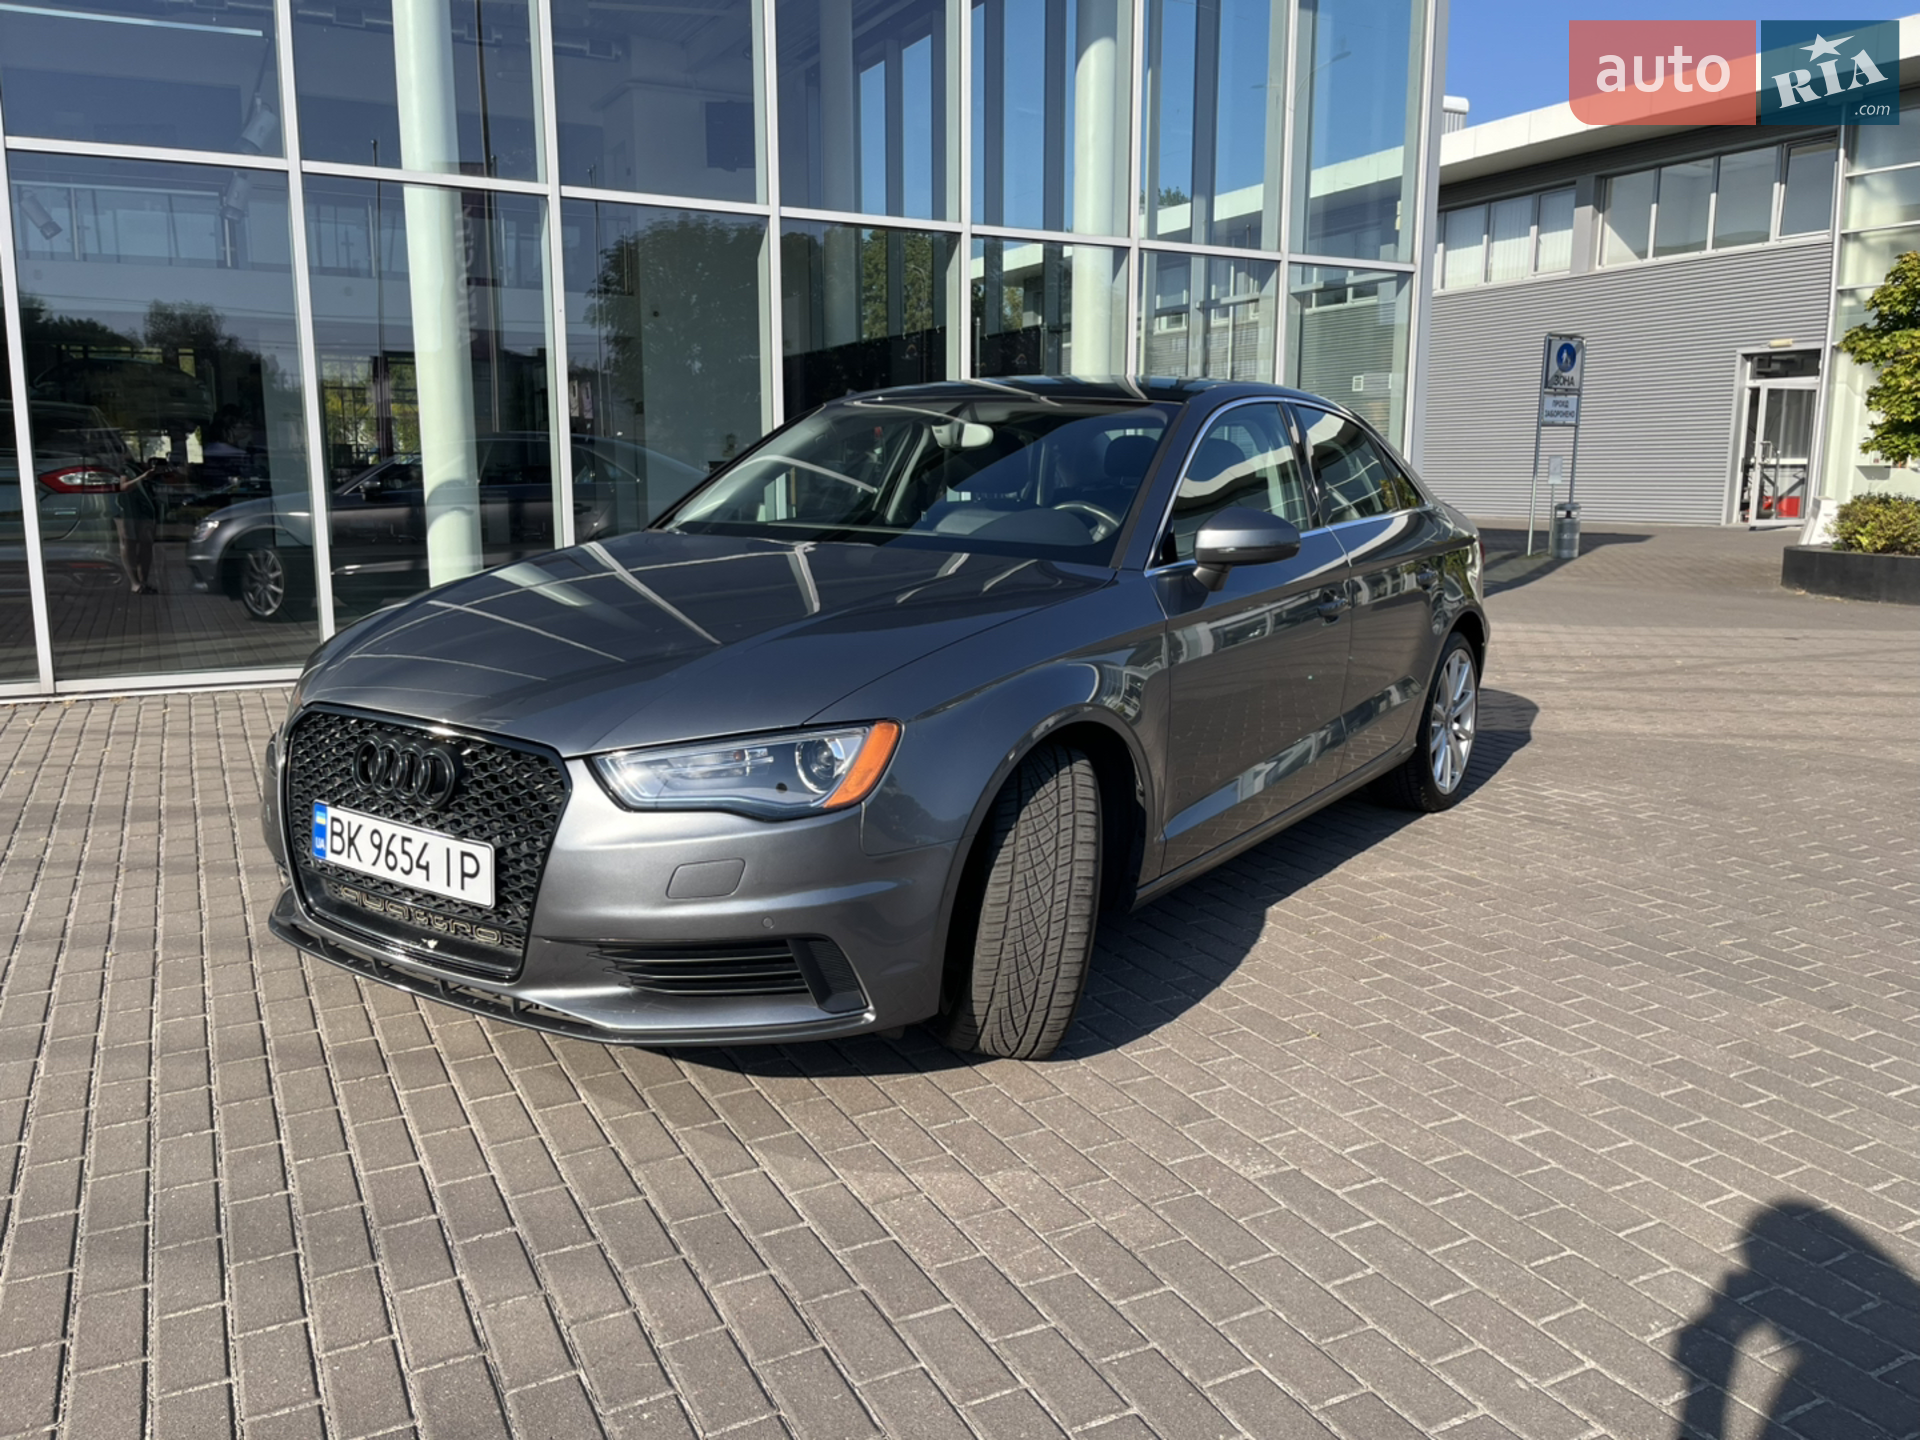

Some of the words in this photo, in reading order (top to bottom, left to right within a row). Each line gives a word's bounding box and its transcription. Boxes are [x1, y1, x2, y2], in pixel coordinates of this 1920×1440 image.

[1553, 375, 1575, 387] ЗОНА
[315, 836, 326, 850] UA
[330, 815, 364, 863] BK
[369, 828, 431, 882] 9654
[445, 847, 481, 891] IP
[340, 886, 502, 945] quattro
